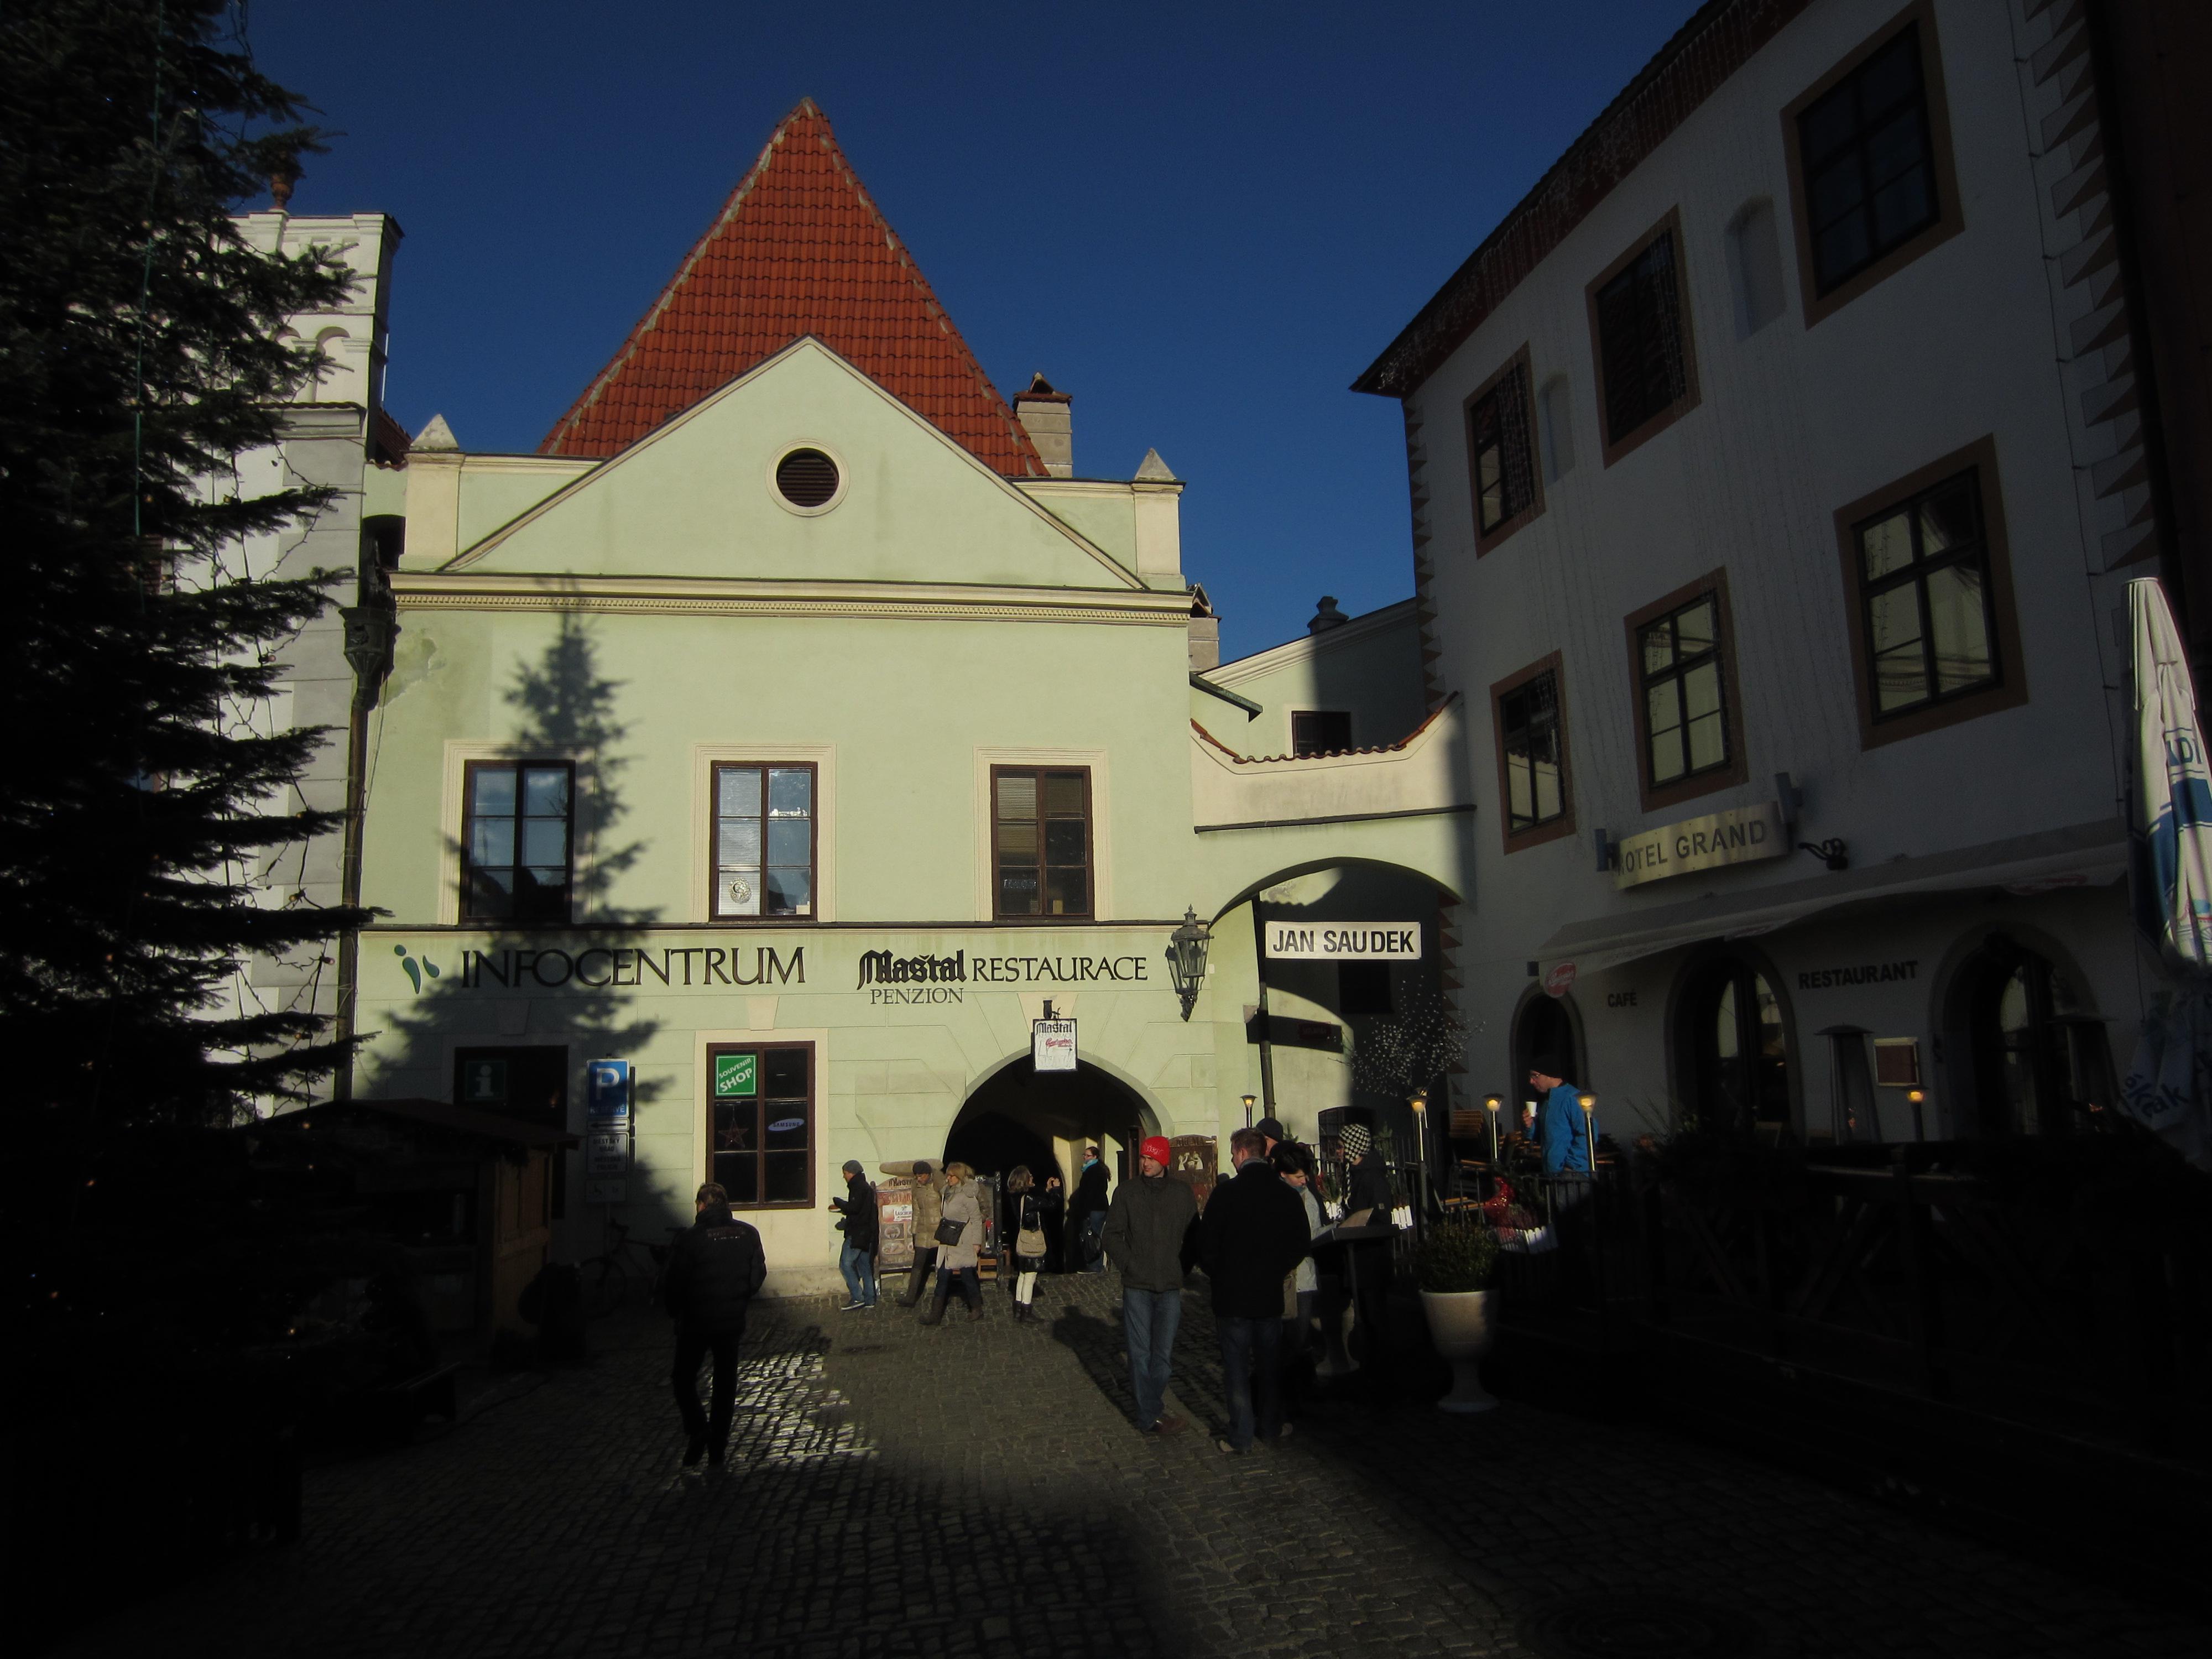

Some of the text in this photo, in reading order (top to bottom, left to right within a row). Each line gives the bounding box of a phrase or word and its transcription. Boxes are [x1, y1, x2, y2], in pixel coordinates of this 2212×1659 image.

[1618, 820, 1766, 876] HOTEL GRAND
[1273, 930, 1415, 953] JAN SAUDEK
[461, 946, 805, 989] INFOCENTRUM
[857, 949, 1148, 990] Maštal RESTAURACE
[1798, 960, 1918, 990] RESTAURANT
[870, 987, 964, 1005] PENZION
[1607, 988, 1637, 1008] CAFÉ
[719, 1057, 753, 1079] SOUVENIR
[719, 1067, 753, 1092] SHOP
[595, 1067, 620, 1100] P
